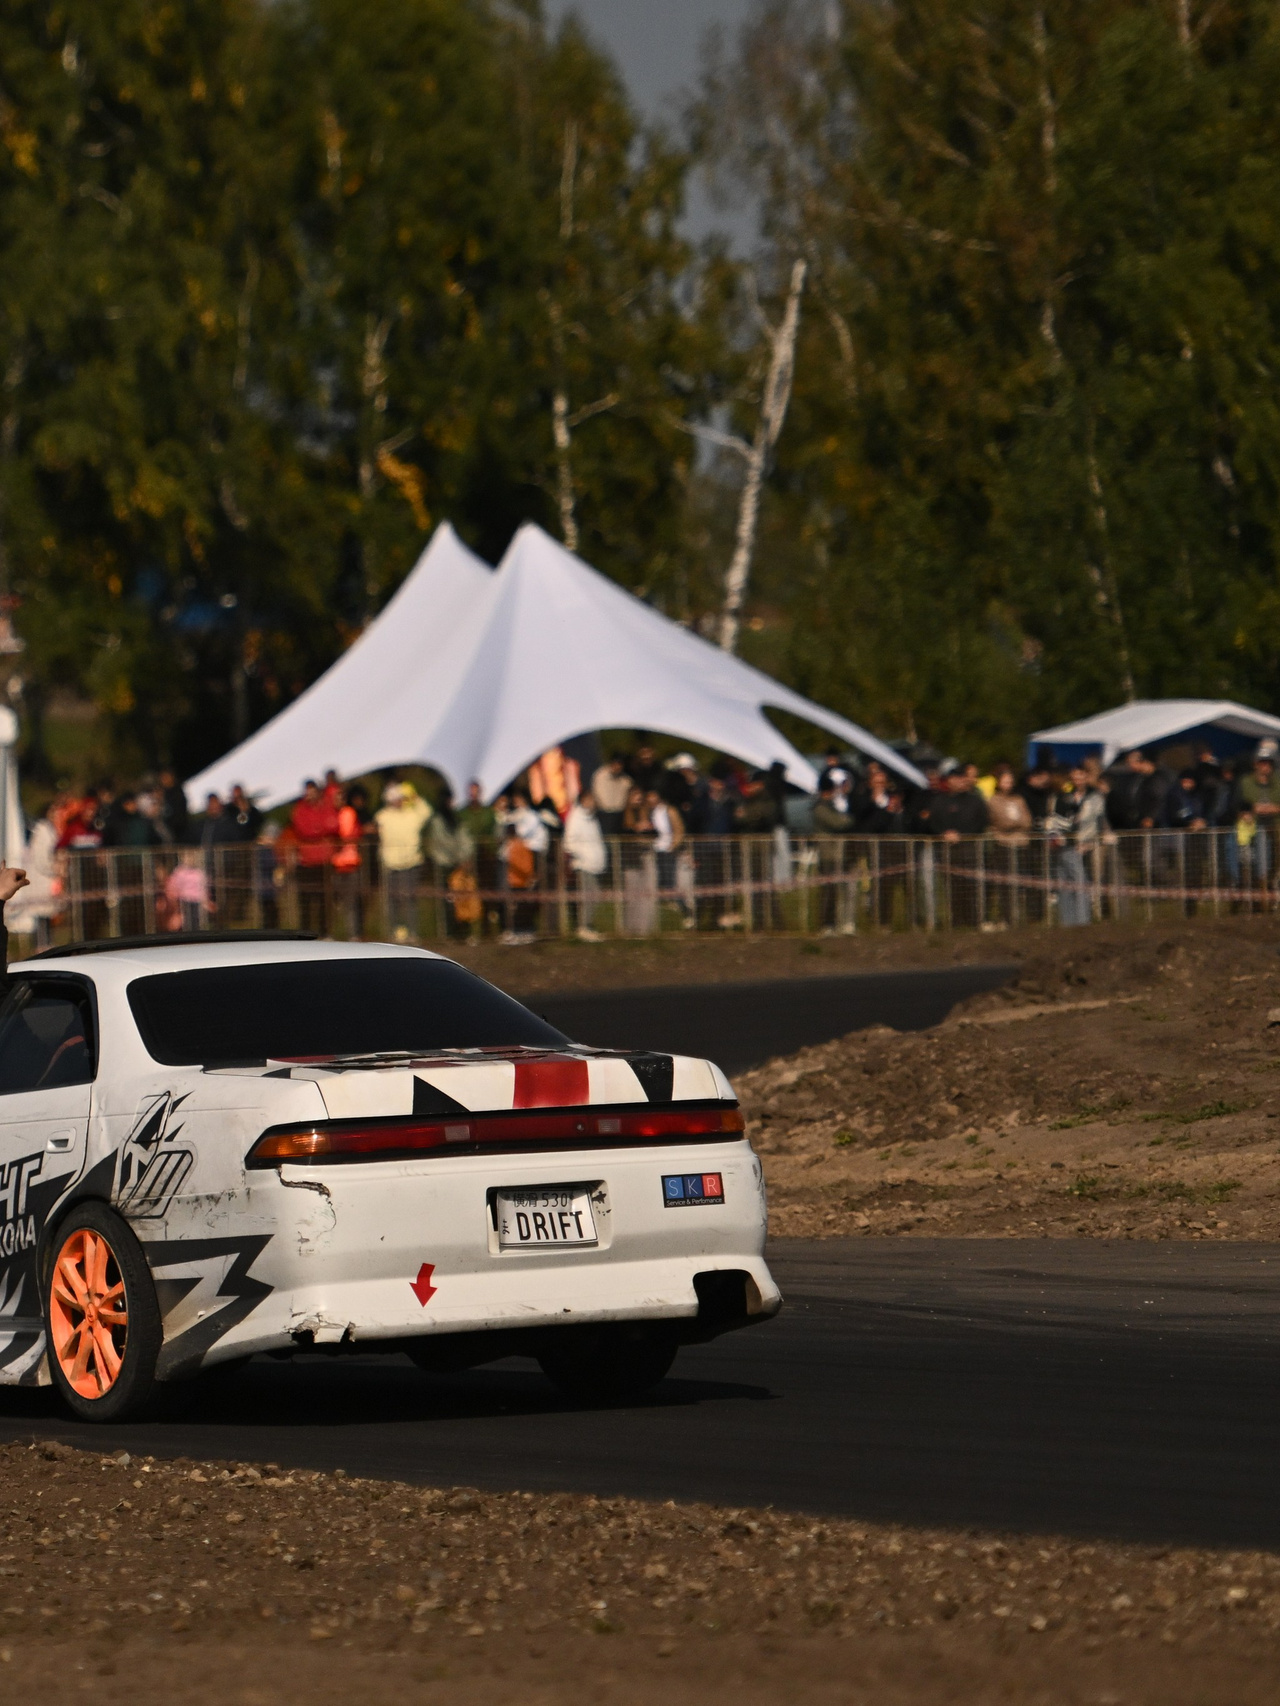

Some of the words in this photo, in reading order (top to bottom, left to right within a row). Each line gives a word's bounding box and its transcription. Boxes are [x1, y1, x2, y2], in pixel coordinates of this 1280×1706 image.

[668, 1177, 718, 1197] SKR
[542, 1192, 568, 1208] 530
[666, 1199, 686, 1207] Service
[516, 1210, 584, 1241] DRIFT
